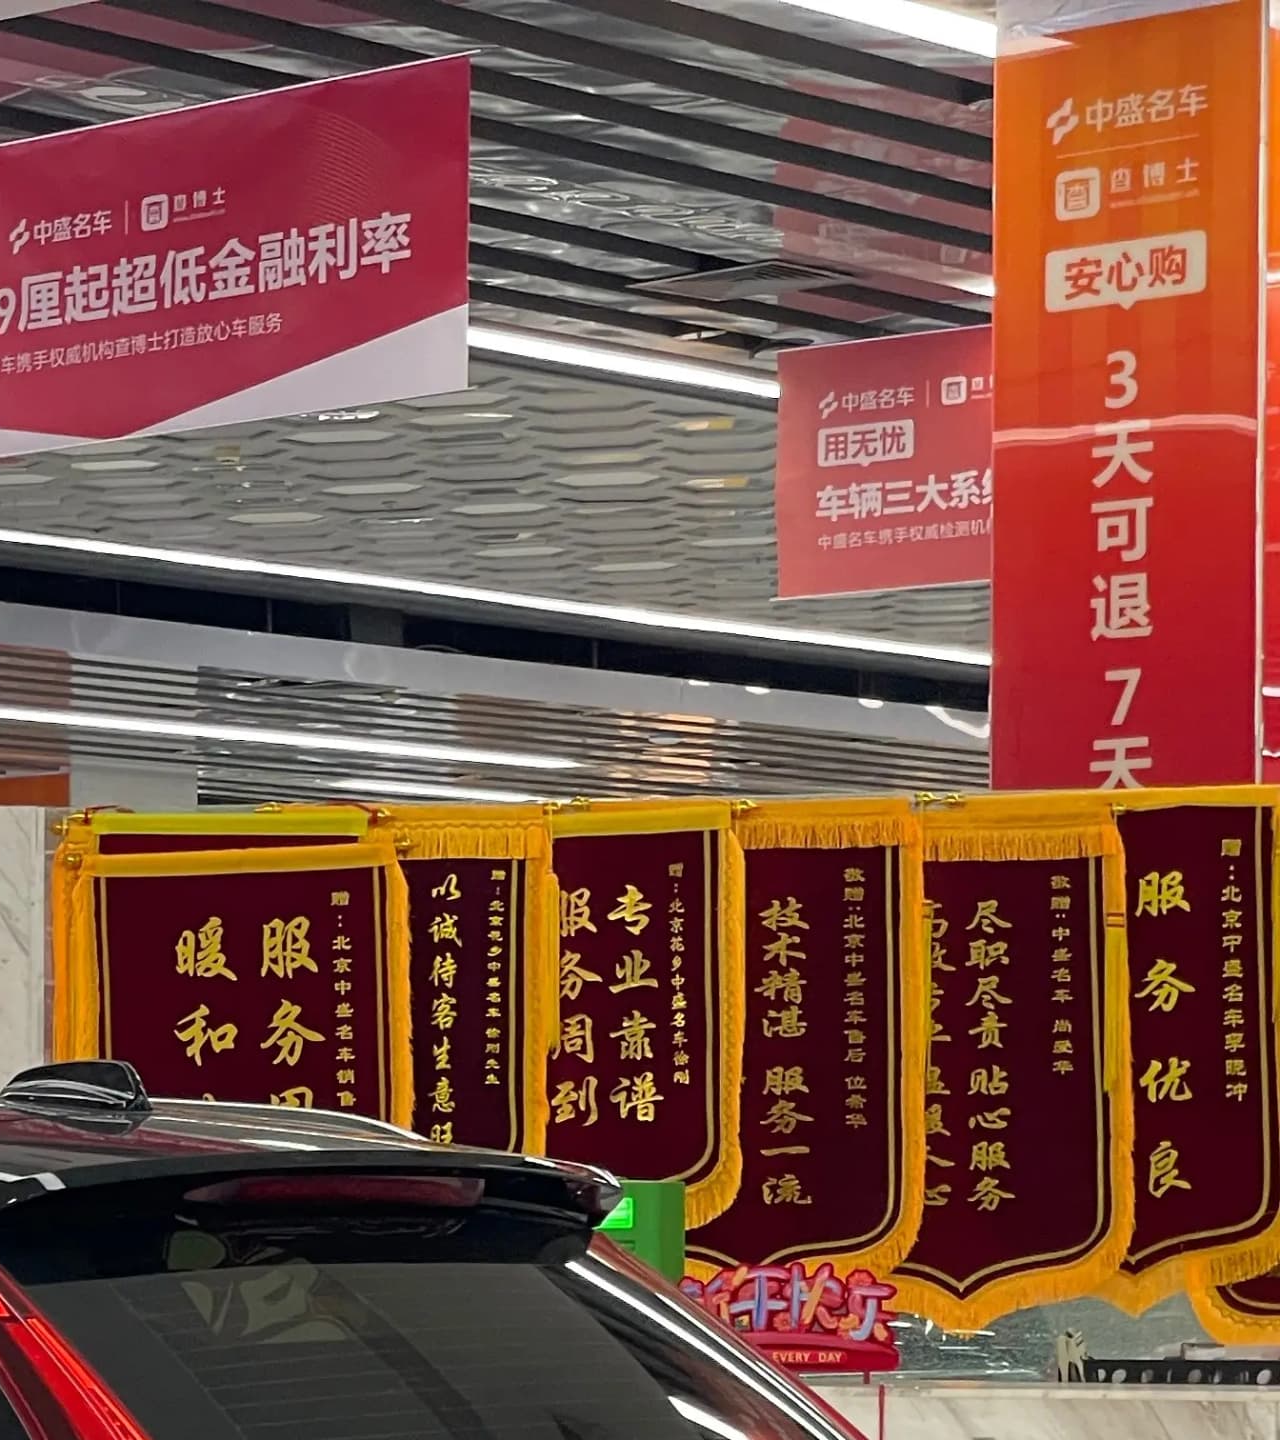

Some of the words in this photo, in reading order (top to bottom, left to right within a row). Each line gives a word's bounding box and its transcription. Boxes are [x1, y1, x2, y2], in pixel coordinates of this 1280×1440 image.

[1085, 84, 1208, 132] 中盛名车
[33, 210, 112, 245] 中盛名车
[1065, 245, 1187, 300] 安心购
[824, 425, 906, 461] 用无忧
[842, 387, 915, 413] 中盛名车
[551, 887, 603, 1126] 服务周到
[607, 885, 664, 1122] 专业靠谱
[754, 896, 810, 1039] 技术精湛
[965, 900, 1013, 1049] 尽职尽责
[1134, 870, 1196, 1198] 服务优良
[759, 1066, 814, 1206] 服务一流
[967, 1065, 1016, 1211] 贴心服务
[772, 1352, 809, 1363] EVERY
[819, 1352, 842, 1363] DAY
